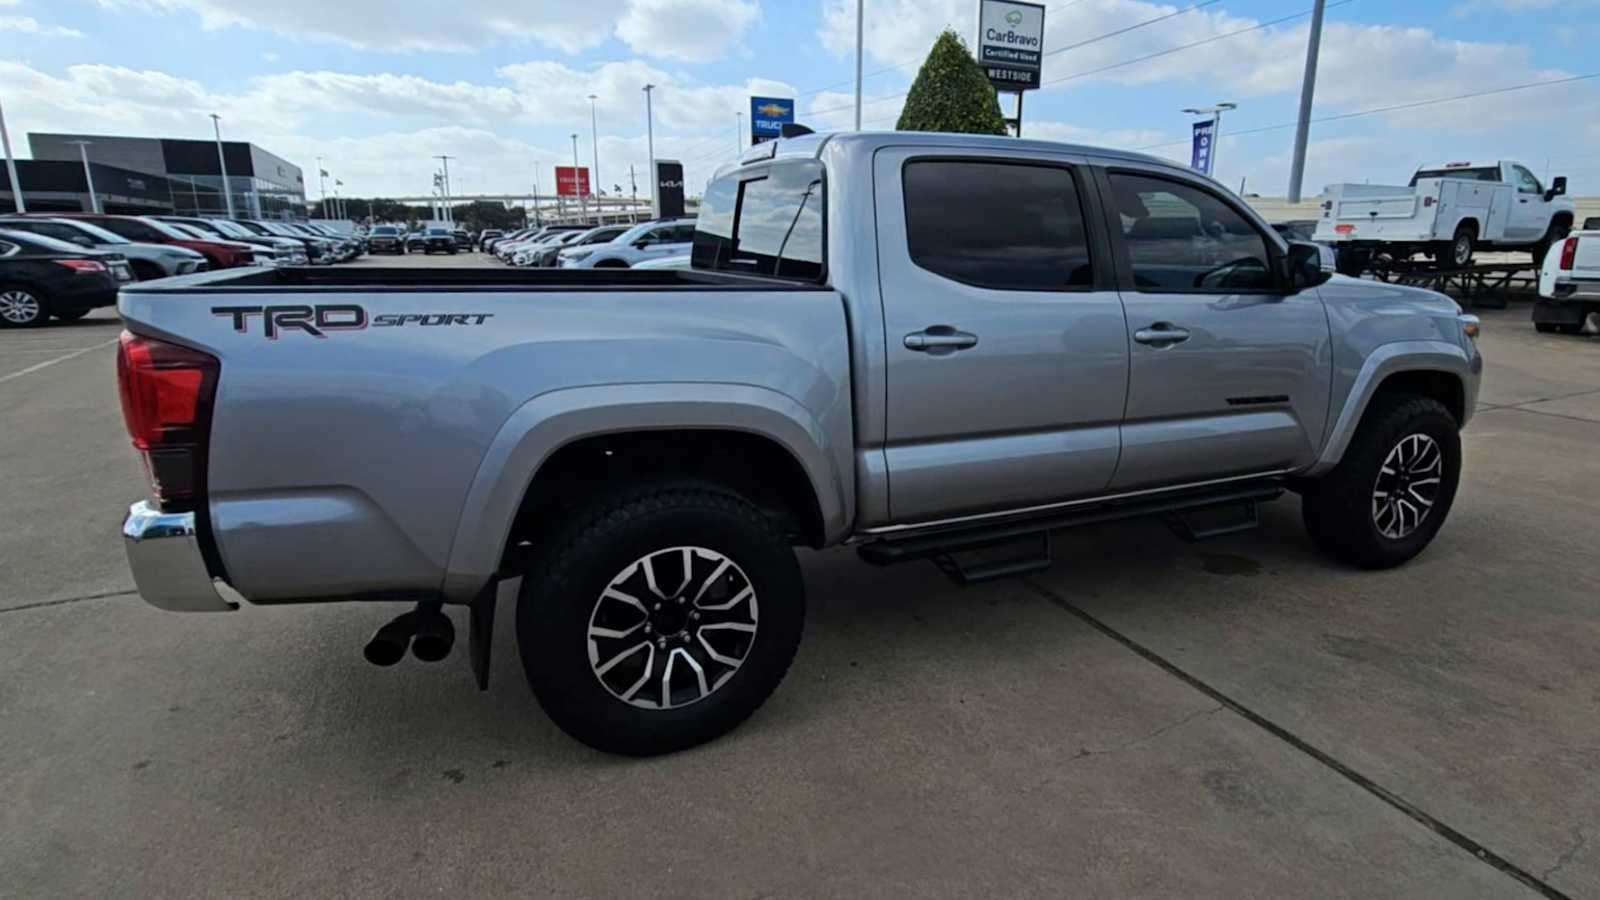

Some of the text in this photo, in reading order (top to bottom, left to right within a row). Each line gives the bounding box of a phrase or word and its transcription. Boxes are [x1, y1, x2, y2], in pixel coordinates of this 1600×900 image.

[986, 28, 1038, 46] CarBravo
[988, 68, 1032, 82] WESTSIDE
[211, 304, 495, 340] TRD SPORT
